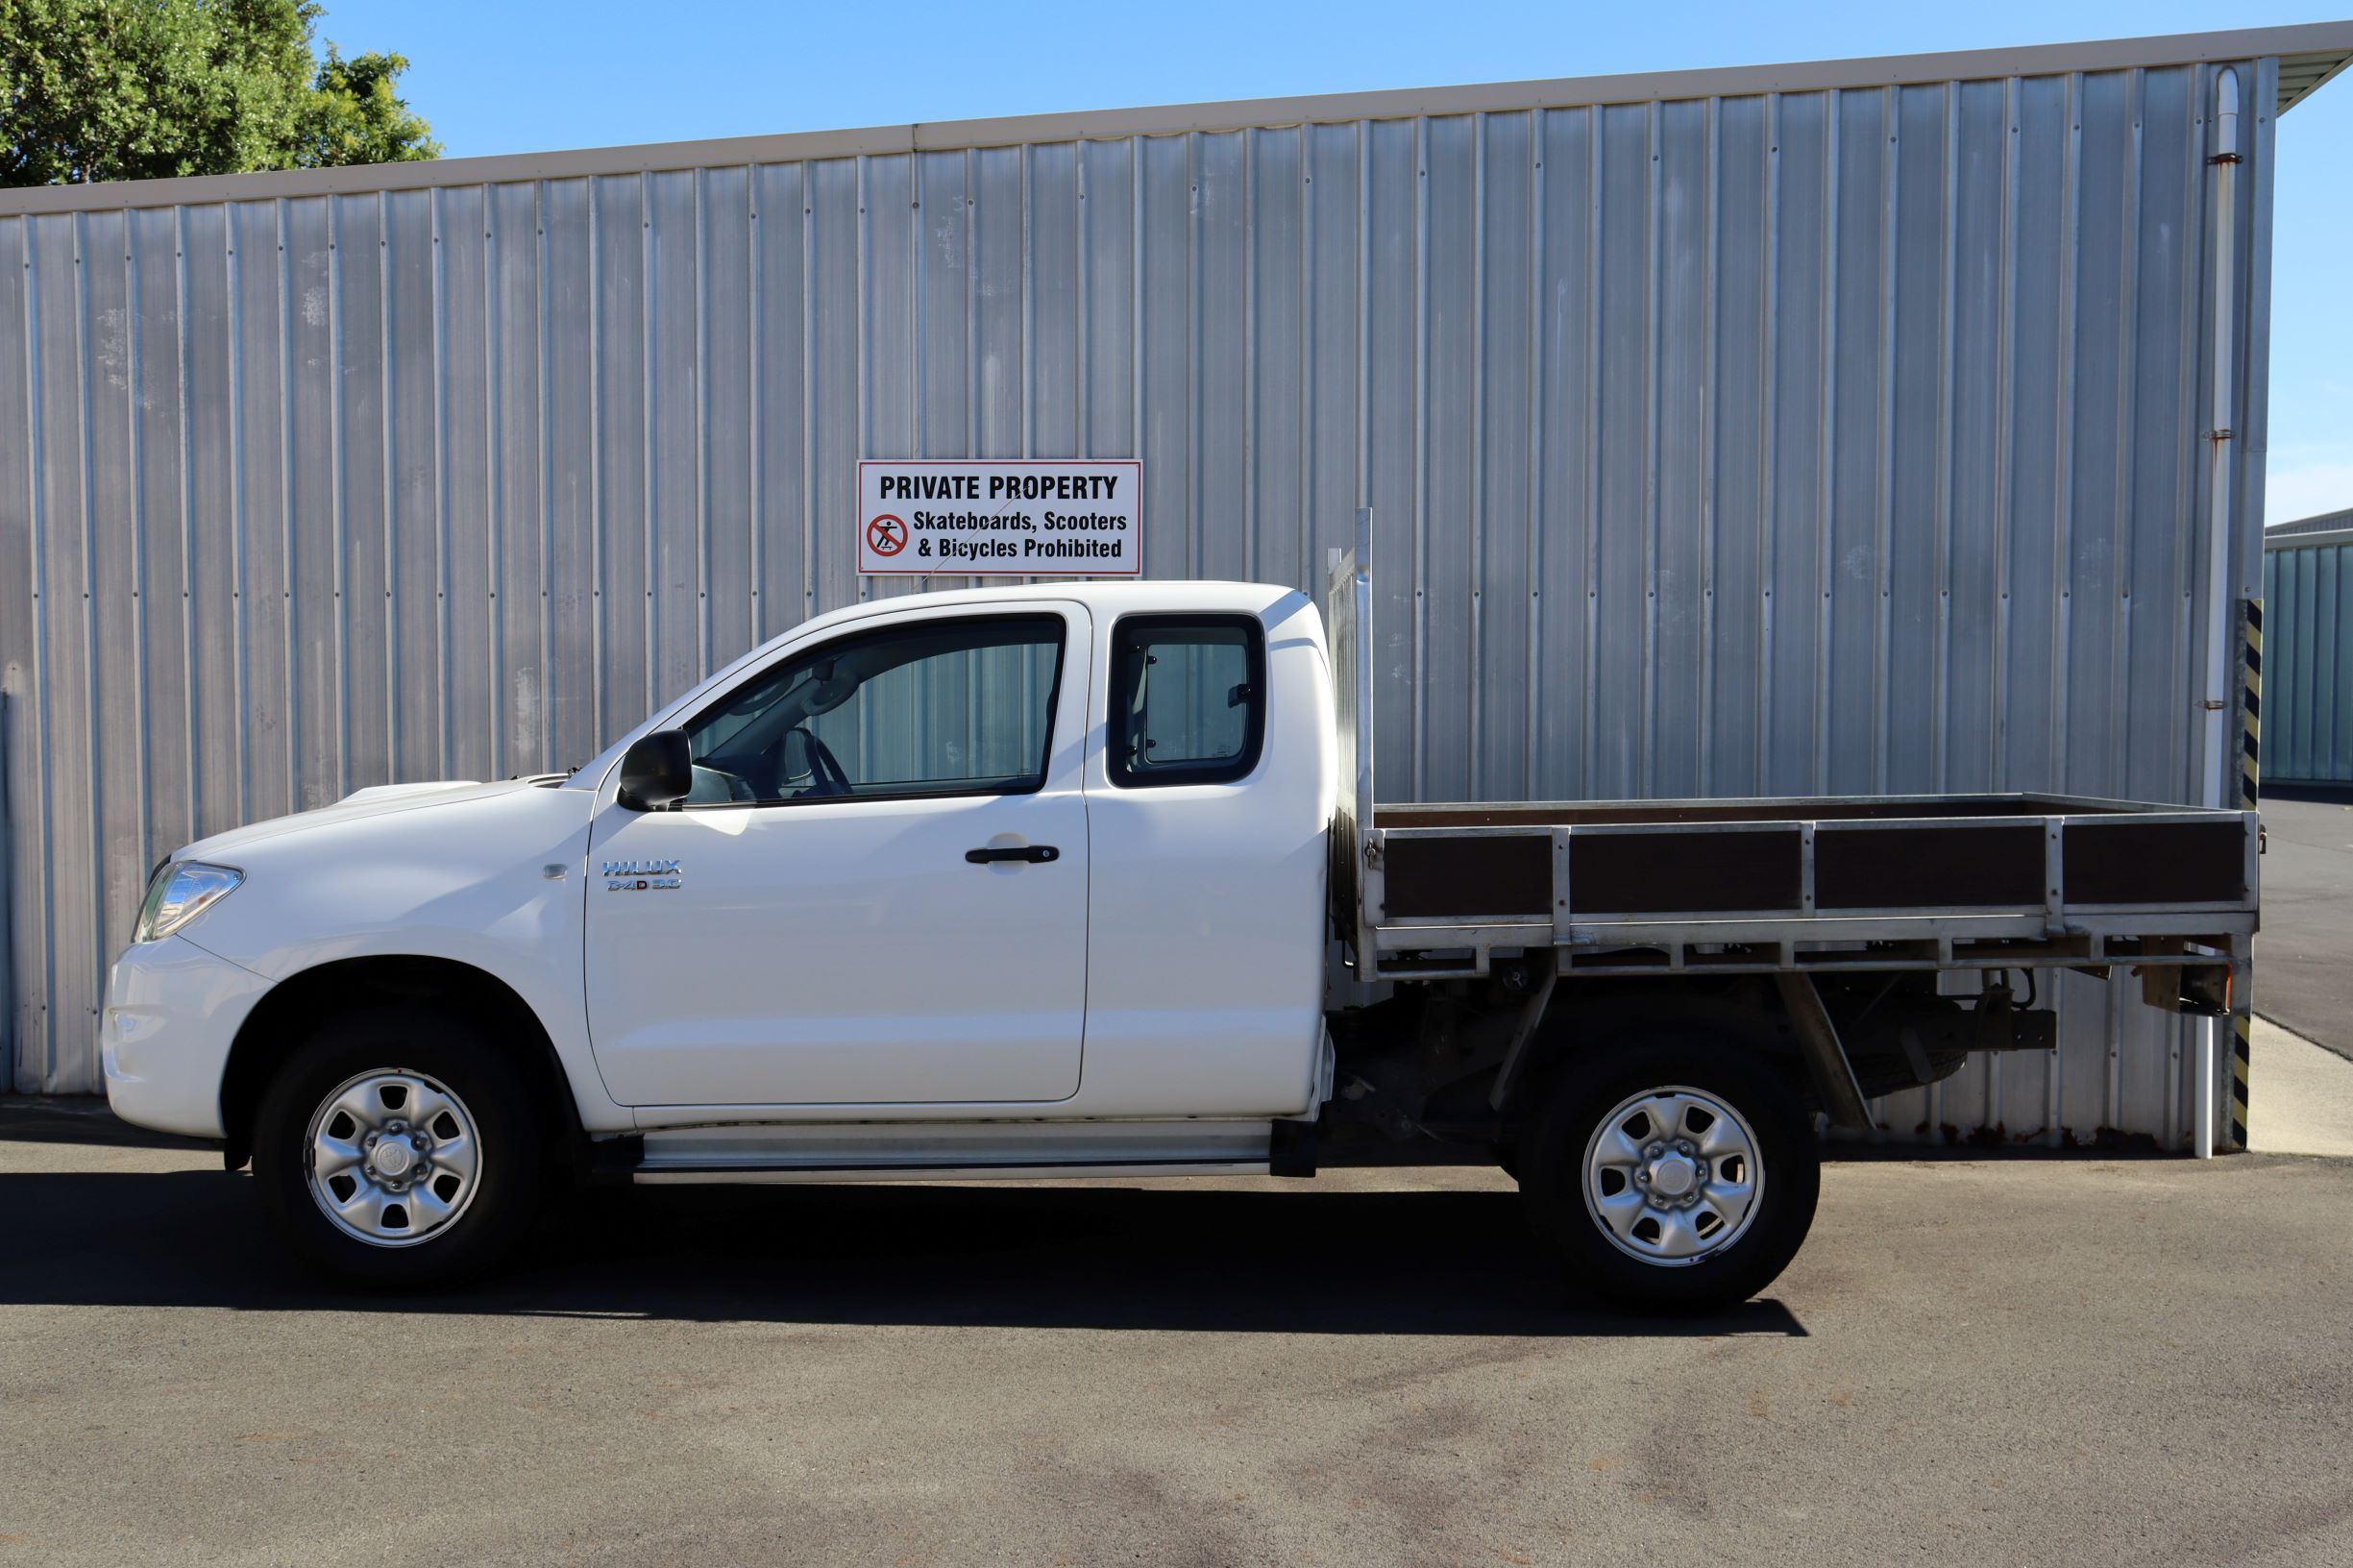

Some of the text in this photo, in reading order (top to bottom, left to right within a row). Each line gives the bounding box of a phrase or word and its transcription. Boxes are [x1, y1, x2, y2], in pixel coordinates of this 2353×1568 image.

[880, 476, 1118, 500] PRIVATE PROPERTY
[914, 510, 1127, 533] Skateboards, Scooters
[918, 538, 1122, 561] & Bicycles Prohibited
[602, 860, 682, 876] HILUX
